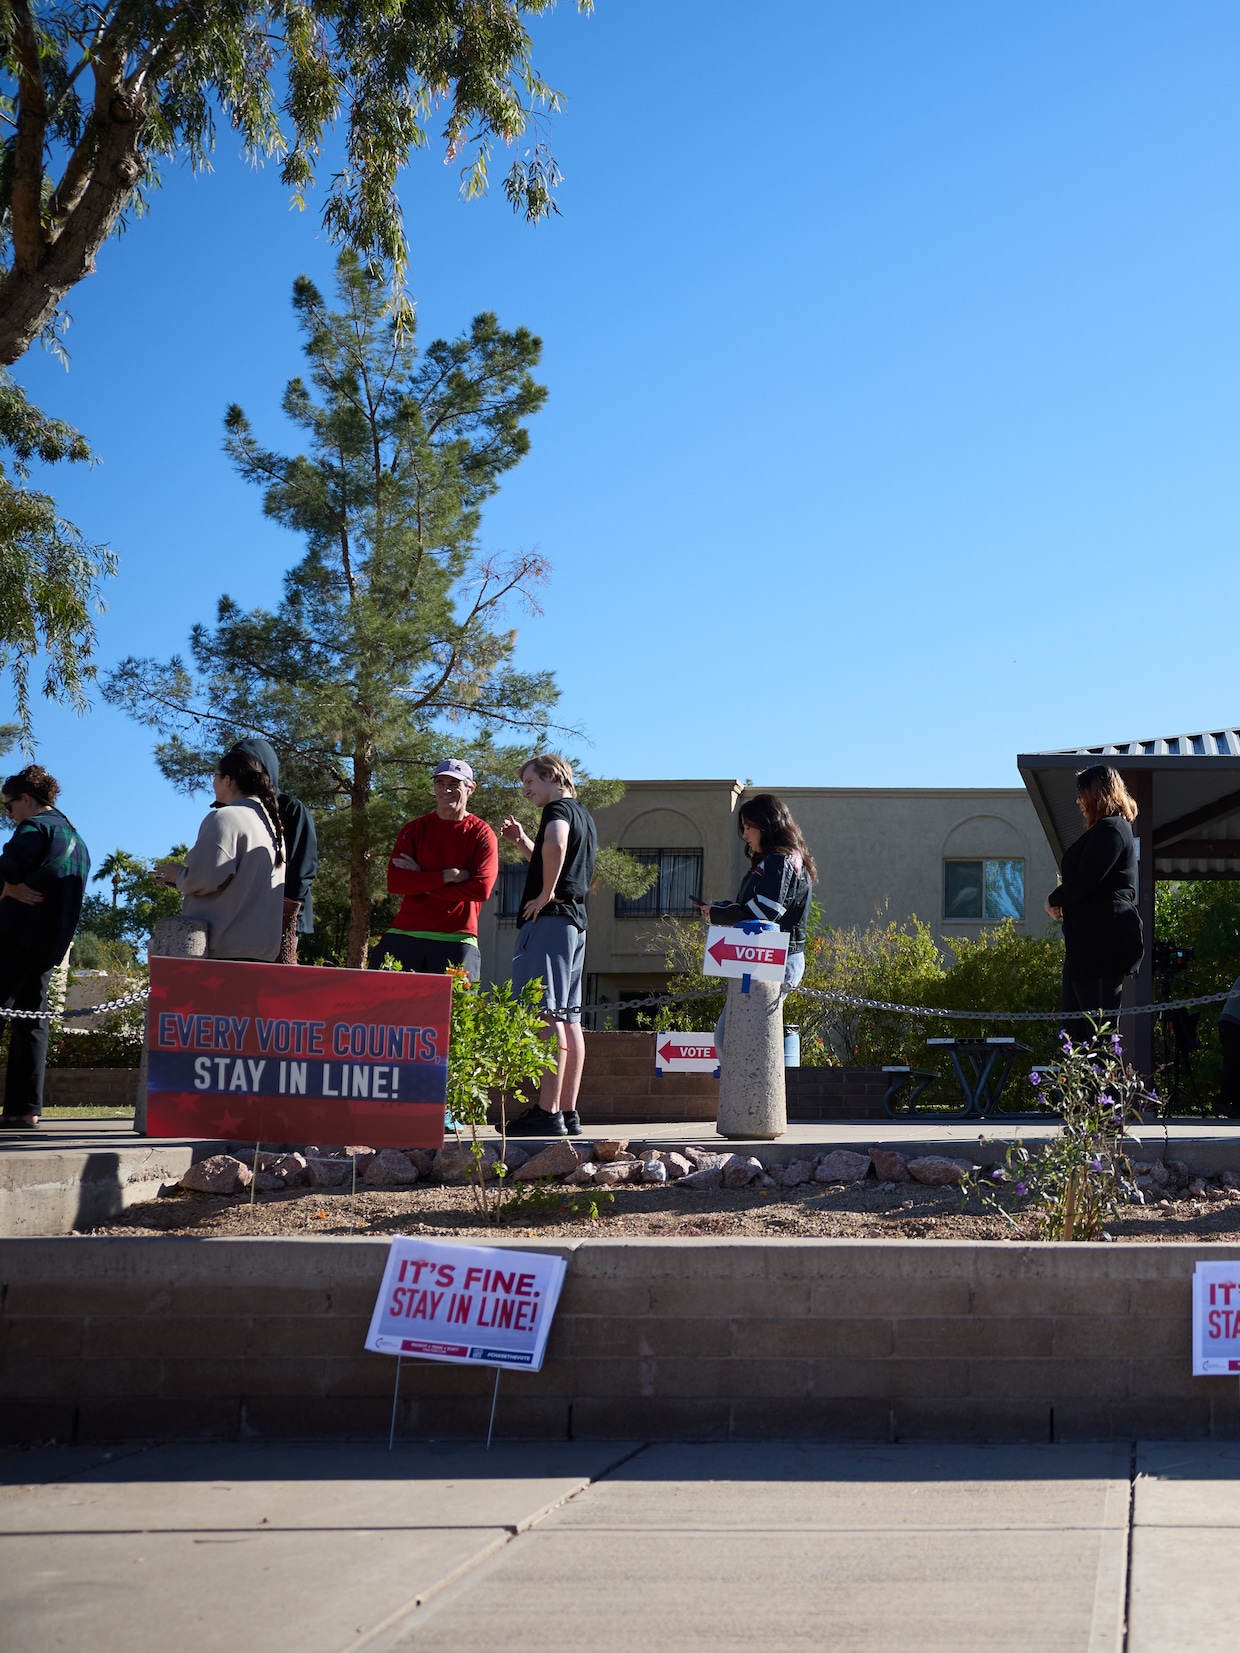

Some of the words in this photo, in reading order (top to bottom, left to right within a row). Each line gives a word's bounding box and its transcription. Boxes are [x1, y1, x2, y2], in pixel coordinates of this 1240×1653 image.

[735, 946, 774, 962] VOTE
[158, 1012, 250, 1050] EVERY
[255, 1017, 326, 1055] VOTE
[332, 1022, 440, 1064] COUNTS,
[680, 1047, 711, 1058] VOTE
[194, 1057, 266, 1092] STAY
[279, 1061, 307, 1094] IN
[322, 1063, 399, 1099] LINE!
[397, 1260, 456, 1288] IT'S
[463, 1267, 540, 1298] FINE.
[389, 1287, 444, 1321] STAY
[446, 1293, 473, 1325] IN
[477, 1296, 538, 1332] LINE!
[487, 1352, 531, 1362] #CHASETHEVOTE
